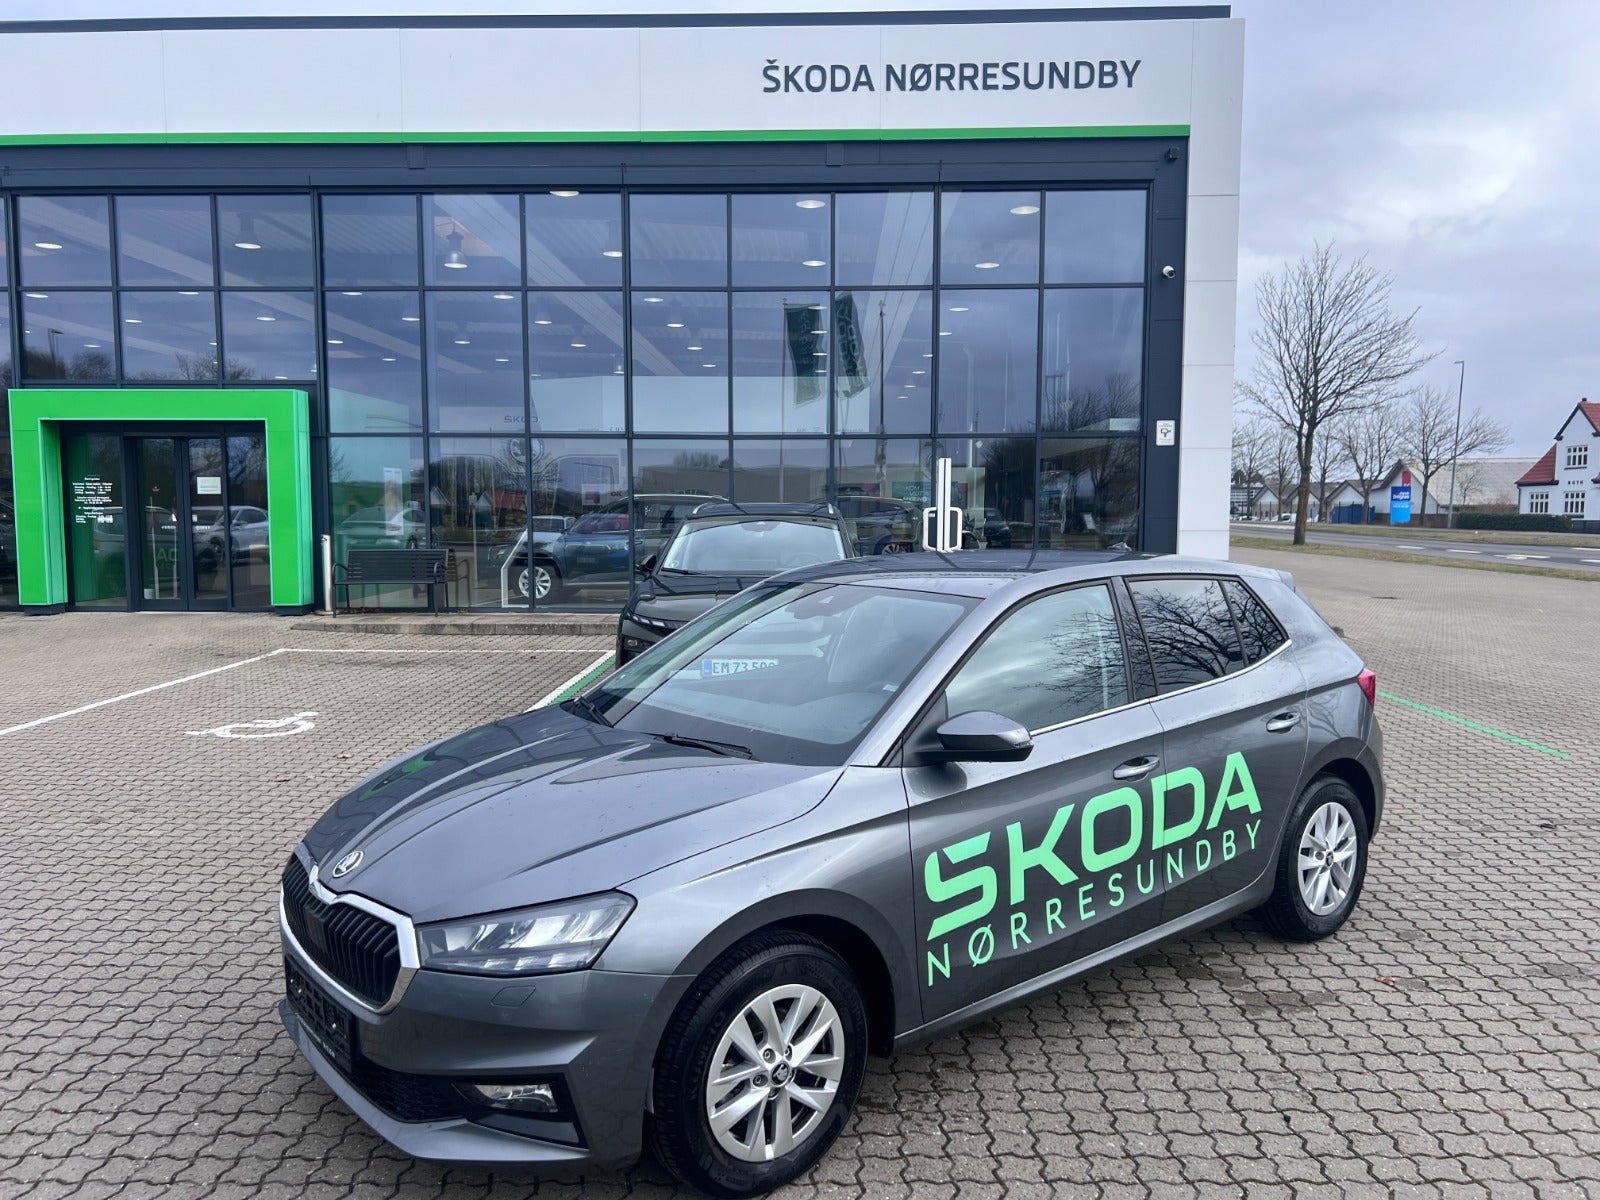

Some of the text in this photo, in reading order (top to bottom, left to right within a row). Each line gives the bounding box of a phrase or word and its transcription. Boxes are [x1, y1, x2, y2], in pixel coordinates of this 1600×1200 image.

[762, 59, 1142, 93] ŠKODA NØRRESUNDBY
[713, 662, 730, 674] EM
[733, 662, 748, 674] 73
[927, 819, 1261, 986] NØRRESUNDBY
